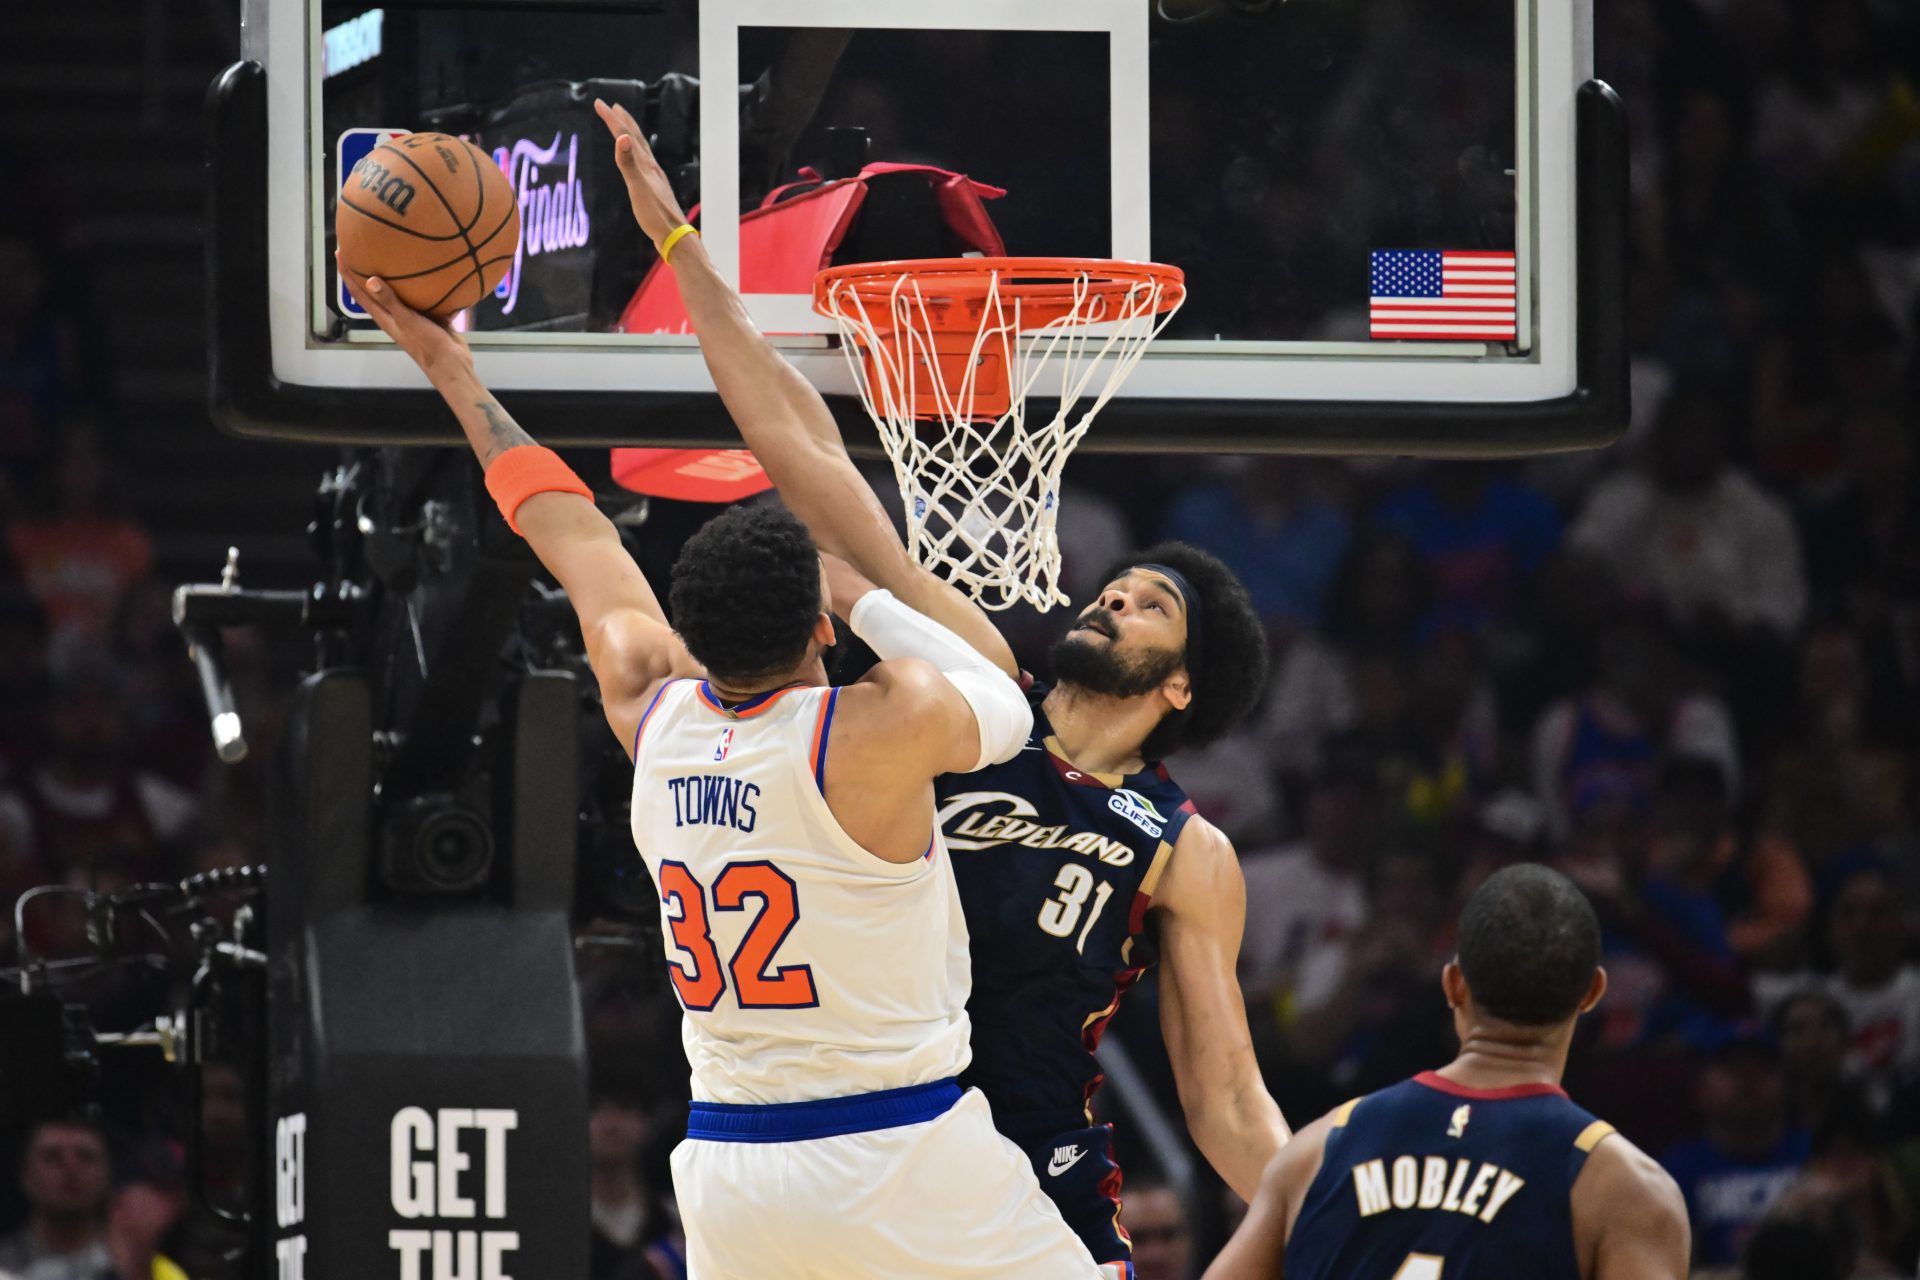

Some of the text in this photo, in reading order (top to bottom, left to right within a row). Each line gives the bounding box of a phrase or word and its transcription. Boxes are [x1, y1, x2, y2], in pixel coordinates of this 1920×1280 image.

[502, 131, 589, 314] Finals
[668, 775, 760, 833] TOWNS
[938, 791, 1135, 867] CLEVELAND
[1111, 799, 1161, 838] CLIFFS
[659, 858, 820, 1012] 32
[1037, 863, 1114, 957] 31
[390, 1106, 518, 1218] GET
[1352, 1154, 1526, 1225] MOBLEY
